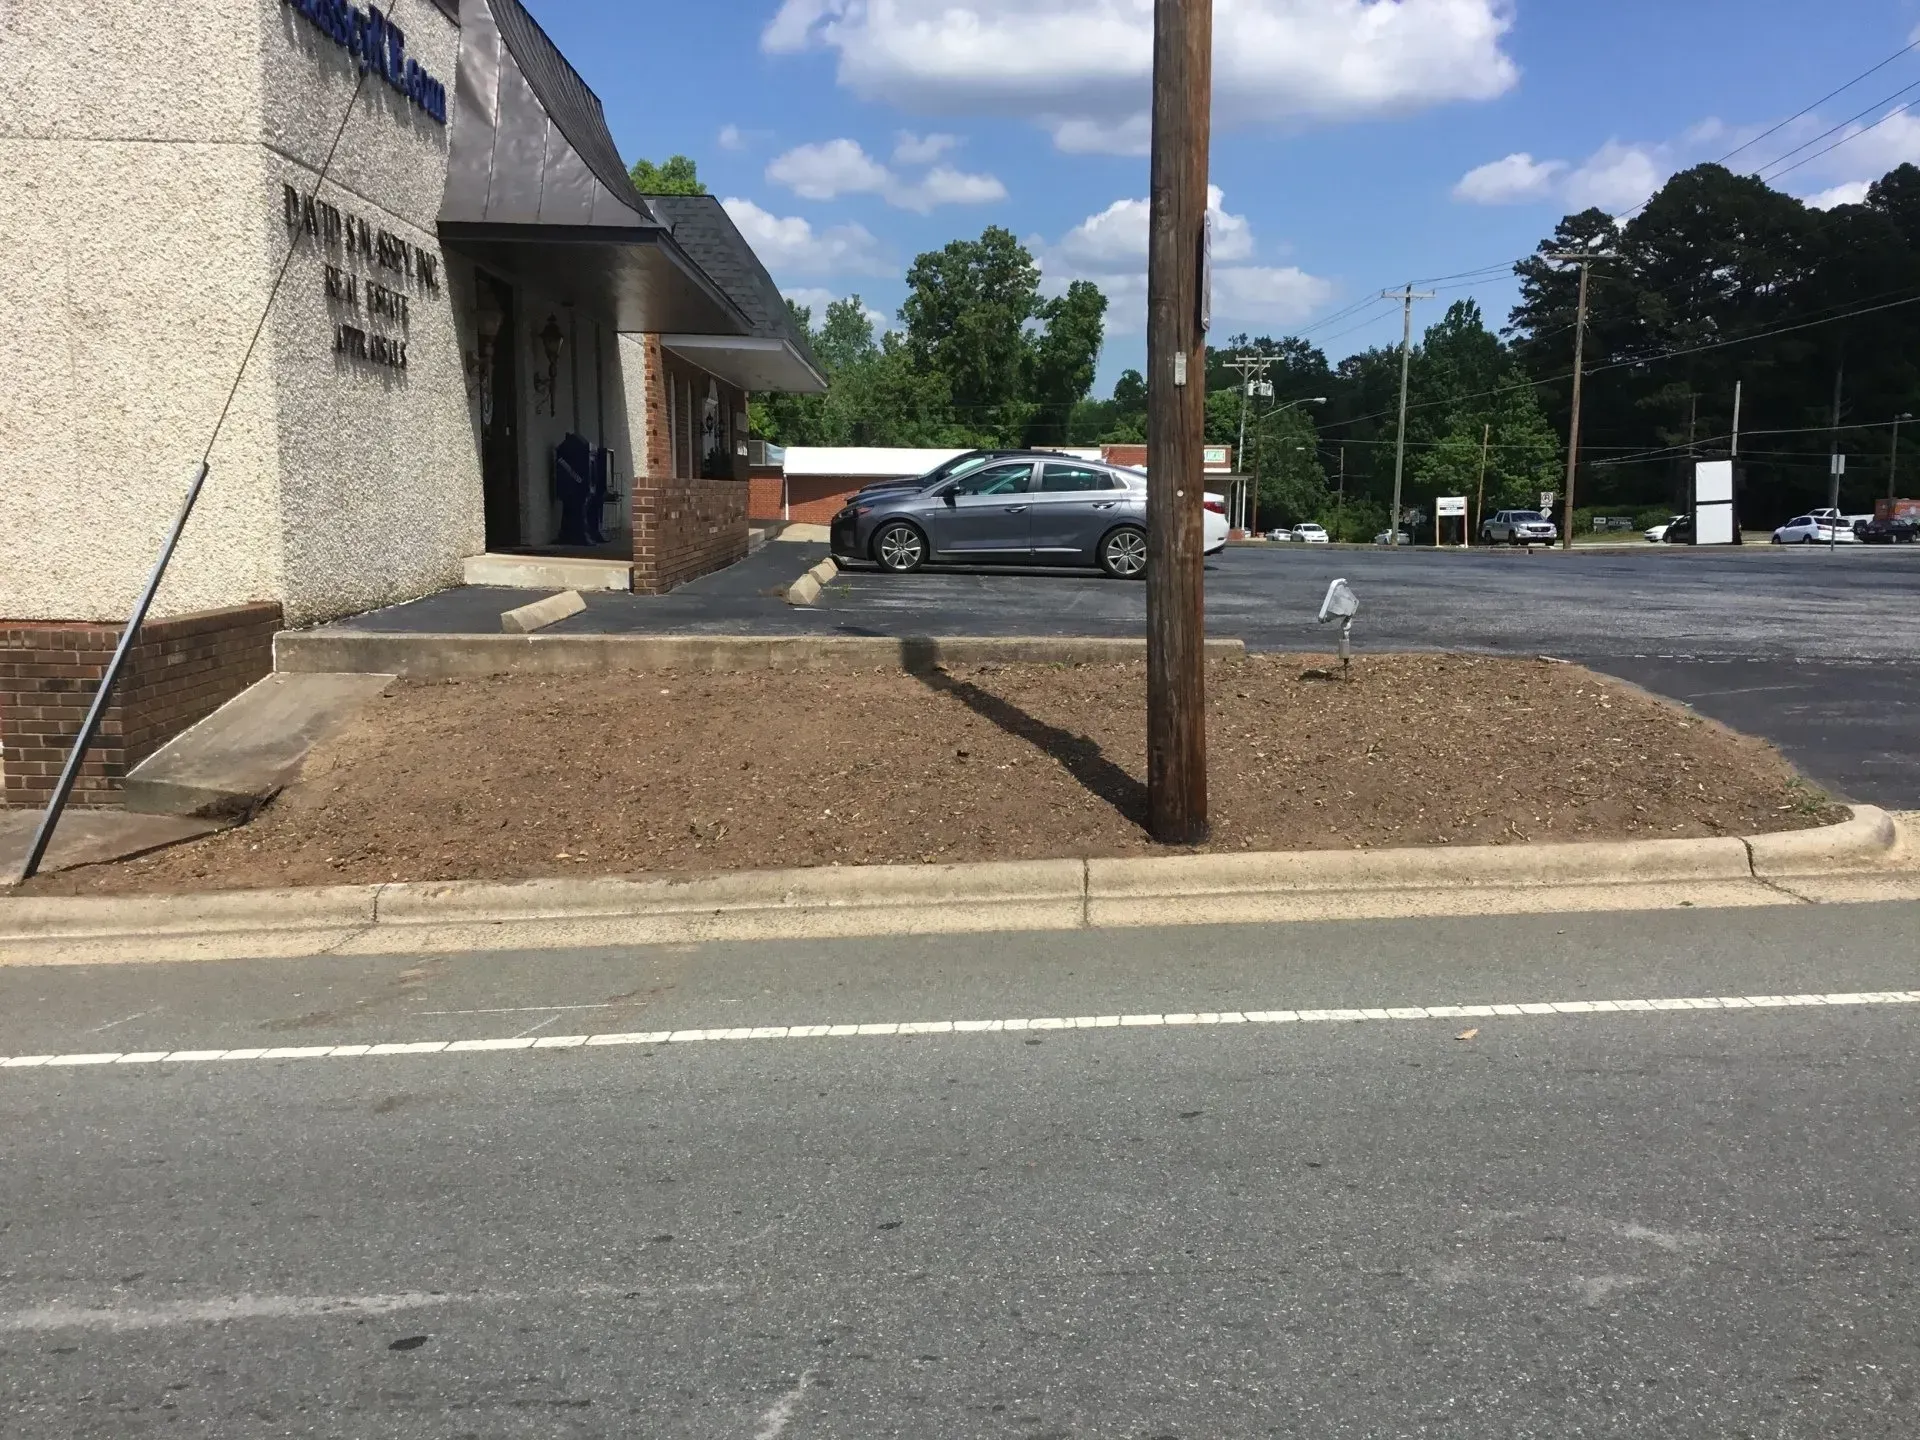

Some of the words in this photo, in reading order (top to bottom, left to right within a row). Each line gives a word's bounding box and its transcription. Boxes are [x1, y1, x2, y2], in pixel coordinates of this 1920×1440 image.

[284, 183, 341, 244] DAVID
[325, 264, 359, 304] REAL
[365, 280, 409, 320] ESTATE
